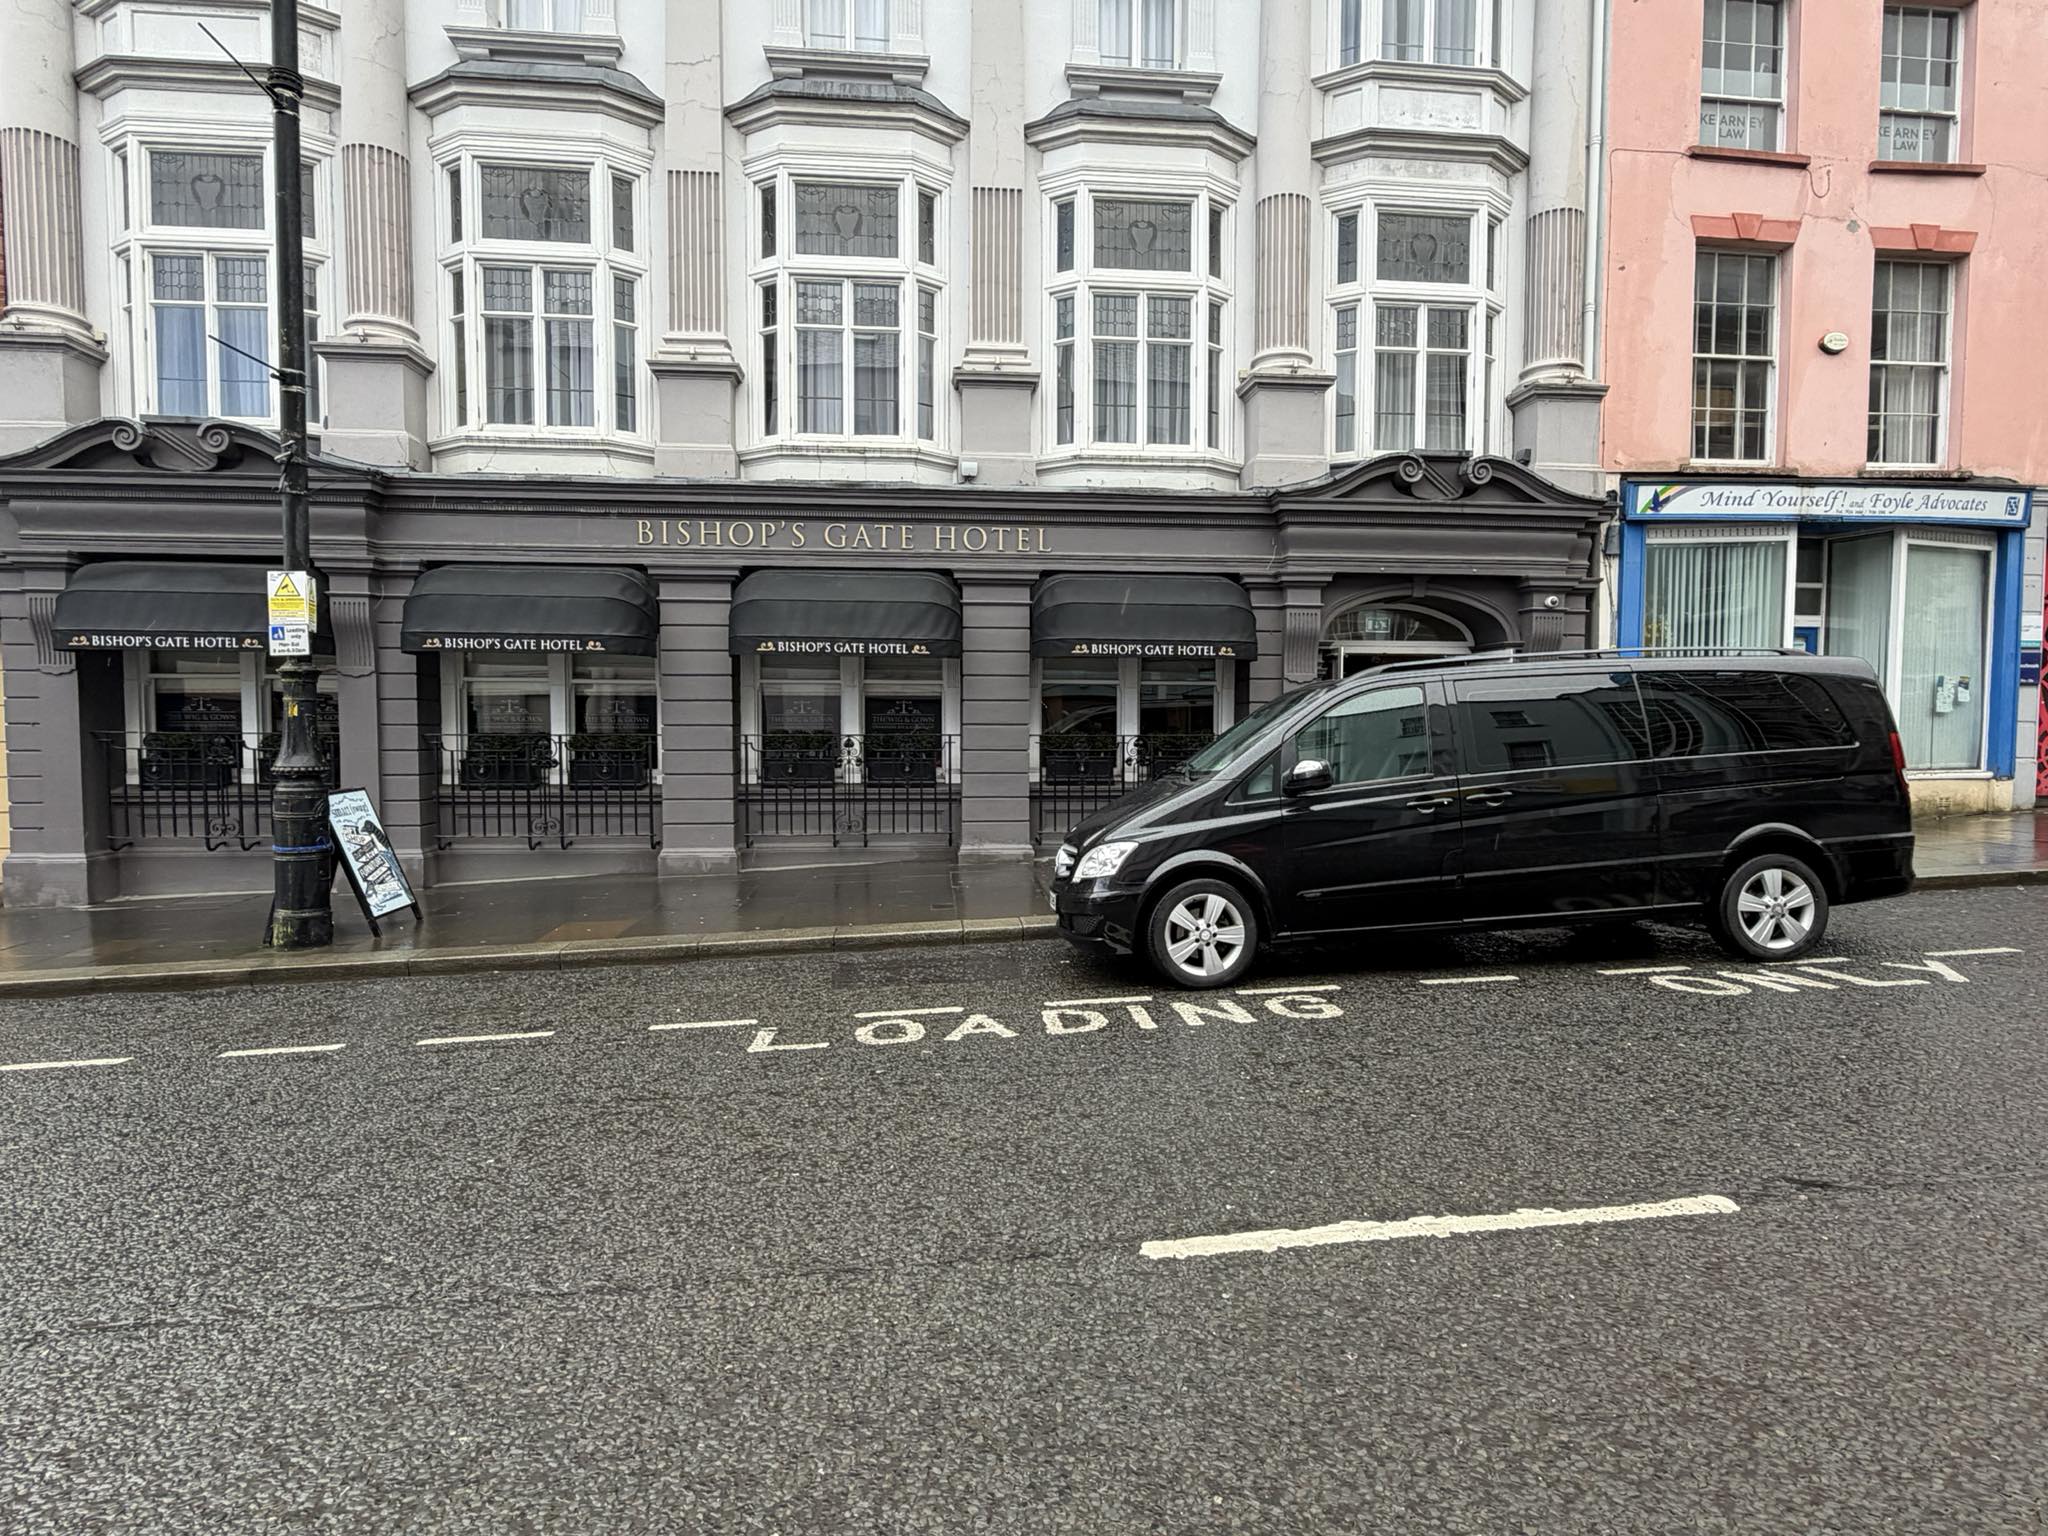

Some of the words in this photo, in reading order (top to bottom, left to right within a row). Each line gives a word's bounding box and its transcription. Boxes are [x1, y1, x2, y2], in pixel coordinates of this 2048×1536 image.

[1700, 113, 1766, 129] KEARNEY
[1718, 128, 1745, 140] LAW
[1893, 140, 1919, 151] LAW
[1700, 489, 1760, 508] Mind
[1762, 489, 1848, 513] Yourself!
[1849, 497, 1867, 508] and
[1870, 491, 1914, 514] Foyle
[1915, 492, 1988, 511] Advocates
[636, 519, 806, 549] BISHOP'S
[824, 523, 915, 550] GATE
[934, 526, 1053, 554] HOTEL
[91, 635, 152, 647] BISHOP'S
[154, 636, 190, 648] GATE
[194, 637, 239, 648] HOTEL
[444, 638, 501, 649] BISHOP'S
[504, 639, 537, 650] GATE
[540, 640, 583, 650] HOTEL
[777, 641, 831, 653] BISHOP'S
[834, 642, 865, 654] GATE
[868, 643, 909, 654] HOTEL
[1091, 644, 1143, 655] BISHOP'S
[1145, 645, 1175, 655] GATE
[1177, 645, 1217, 656] HOTEL
[210, 713, 238, 721] GOWN
[1648, 960, 1971, 997] ONLY
[746, 993, 1345, 1053] LOADING
